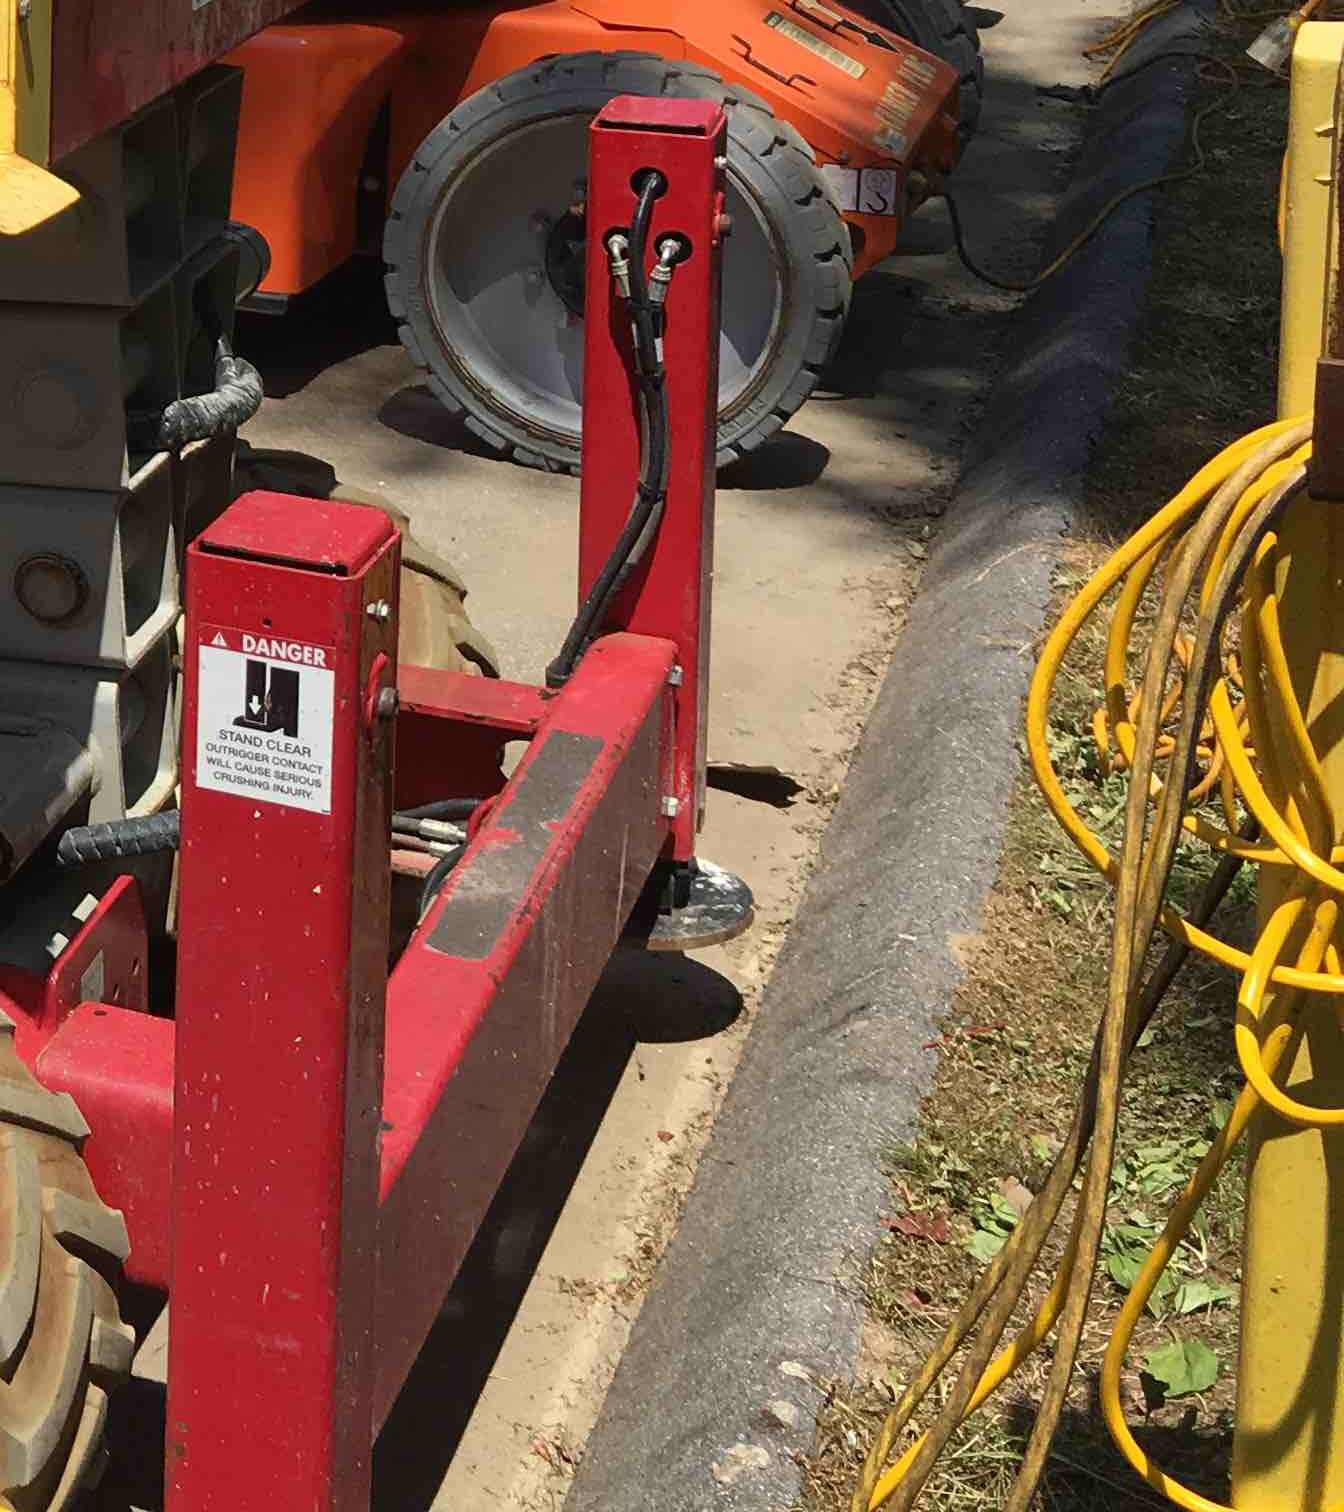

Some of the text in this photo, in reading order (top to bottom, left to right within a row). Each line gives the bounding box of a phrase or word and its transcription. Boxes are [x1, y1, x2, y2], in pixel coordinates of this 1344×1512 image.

[242, 634, 327, 668] DANGER
[205, 742, 324, 776] OUTRIGGER CONTACT
[218, 728, 312, 759] STAND CLEAR
[206, 756, 323, 789] WILL CAUSE SERIOUS
[213, 770, 315, 801] CRUSHING INJURY.
